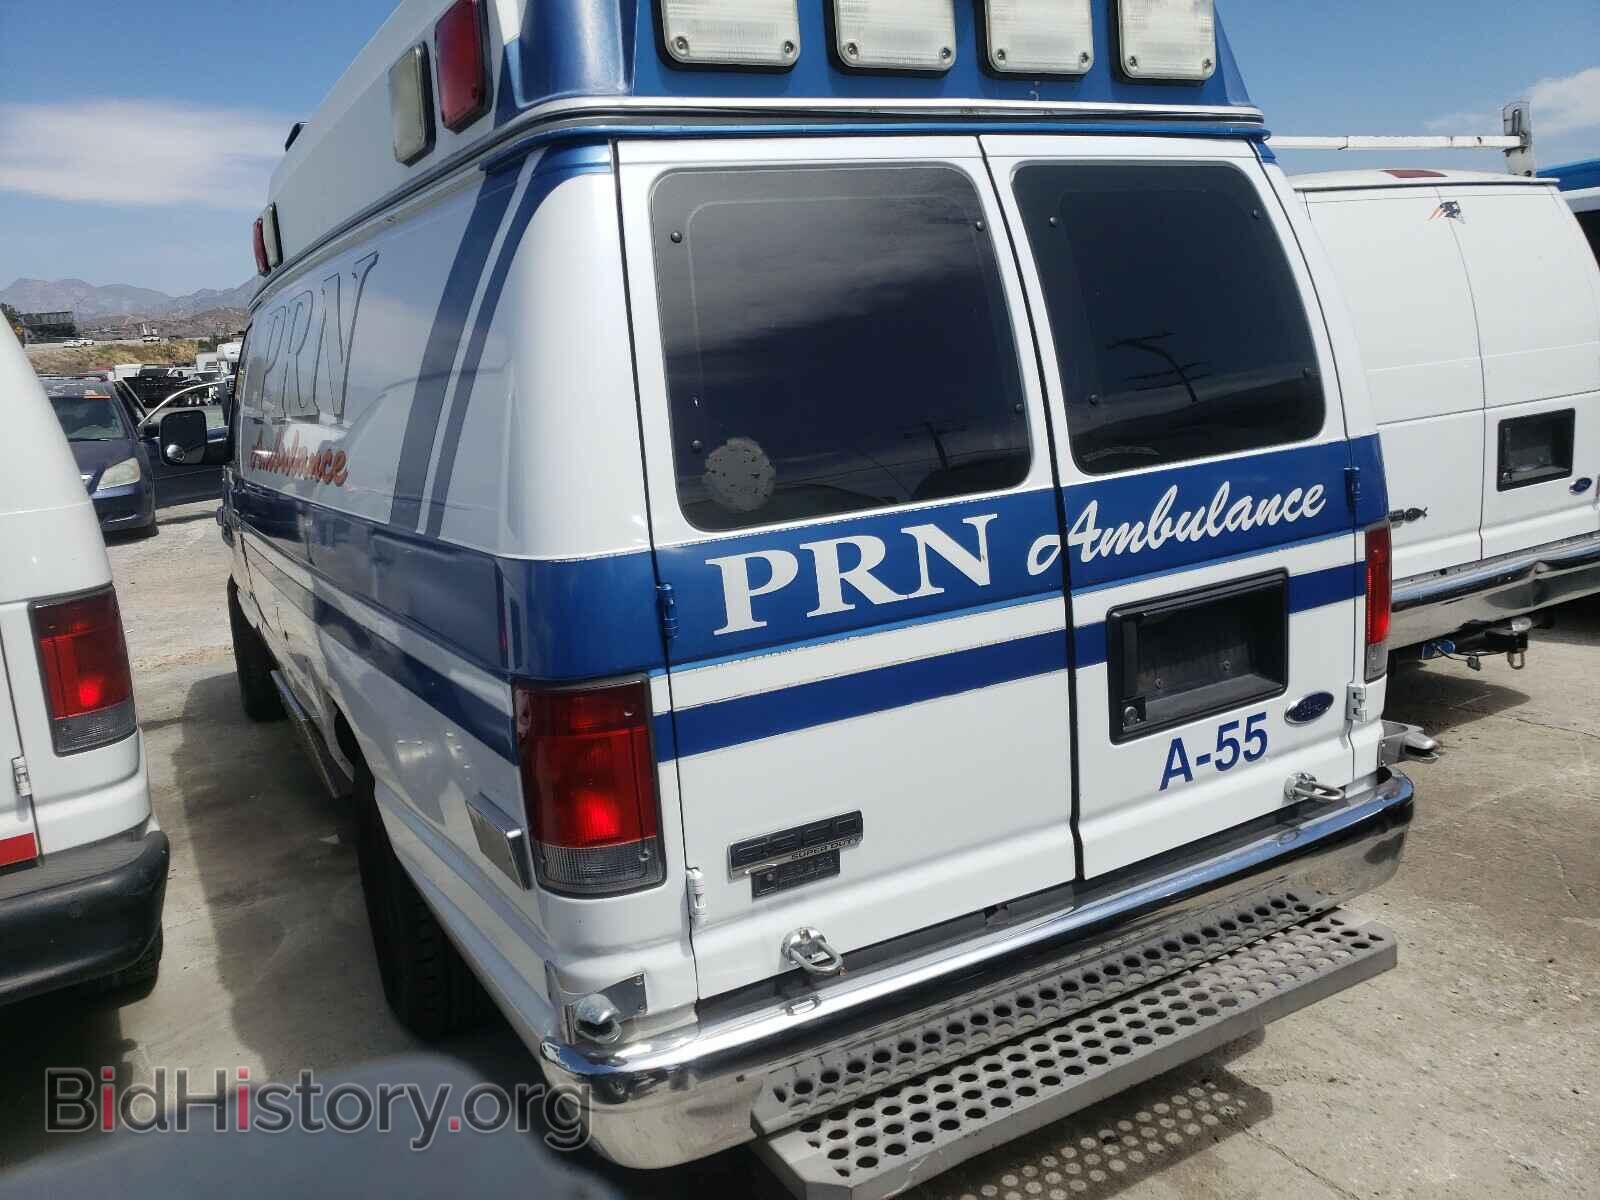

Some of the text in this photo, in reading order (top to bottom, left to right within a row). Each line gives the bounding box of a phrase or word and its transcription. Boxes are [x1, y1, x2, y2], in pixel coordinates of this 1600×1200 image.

[252, 250, 380, 425] PRN
[705, 481, 1326, 636] PRN Ambulance
[1159, 711, 1268, 791] A-55
